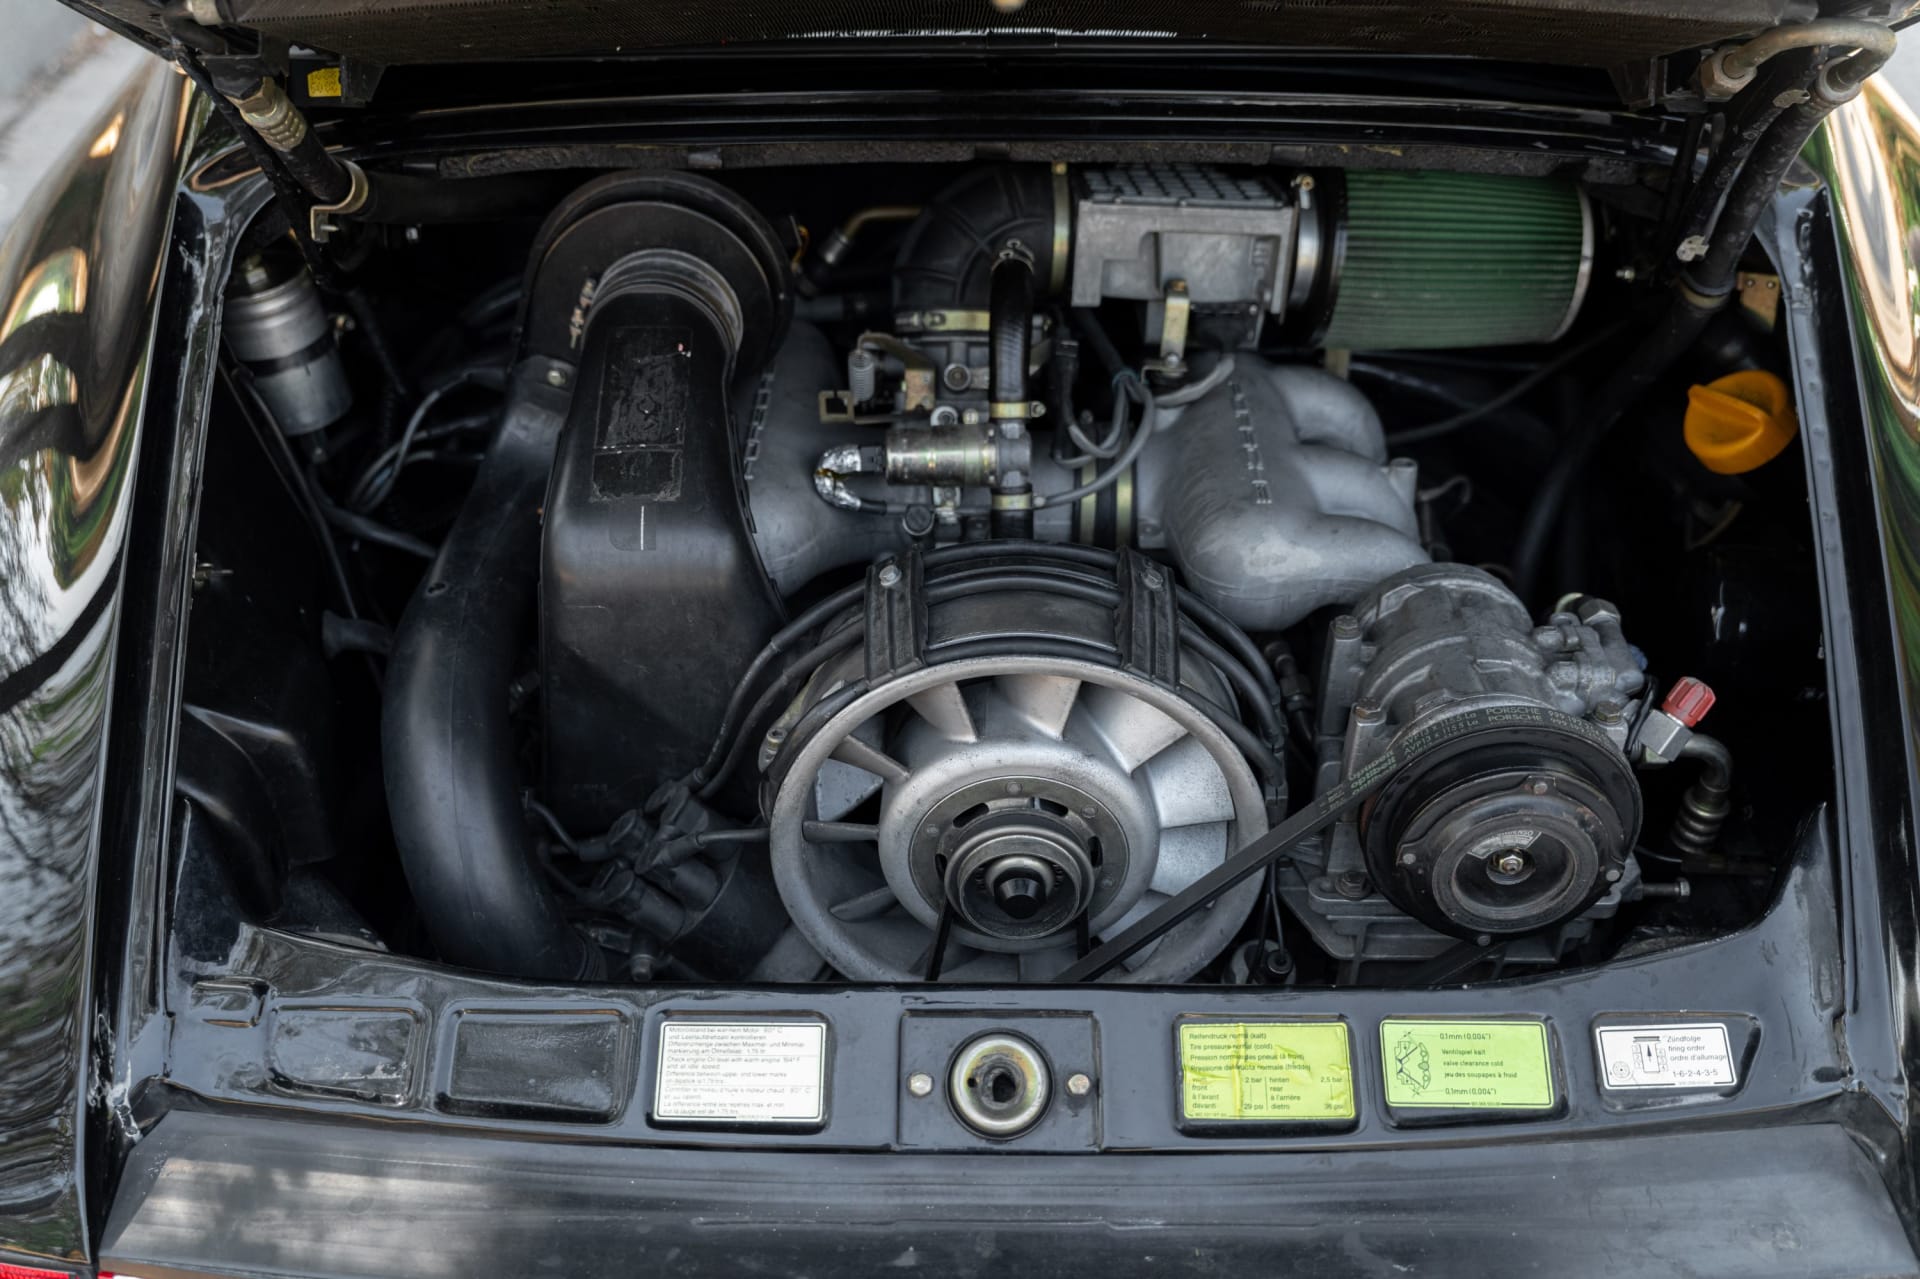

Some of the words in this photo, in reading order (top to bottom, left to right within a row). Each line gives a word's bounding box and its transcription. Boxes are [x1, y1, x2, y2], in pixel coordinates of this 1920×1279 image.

[1486, 706, 1541, 715] PORSCHE
[1351, 756, 1396, 789] optibelt
[1666, 1035, 1702, 1043] Zündfolge
[1245, 1076, 1250, 1084] 2
[1250, 1076, 1263, 1084] bar
